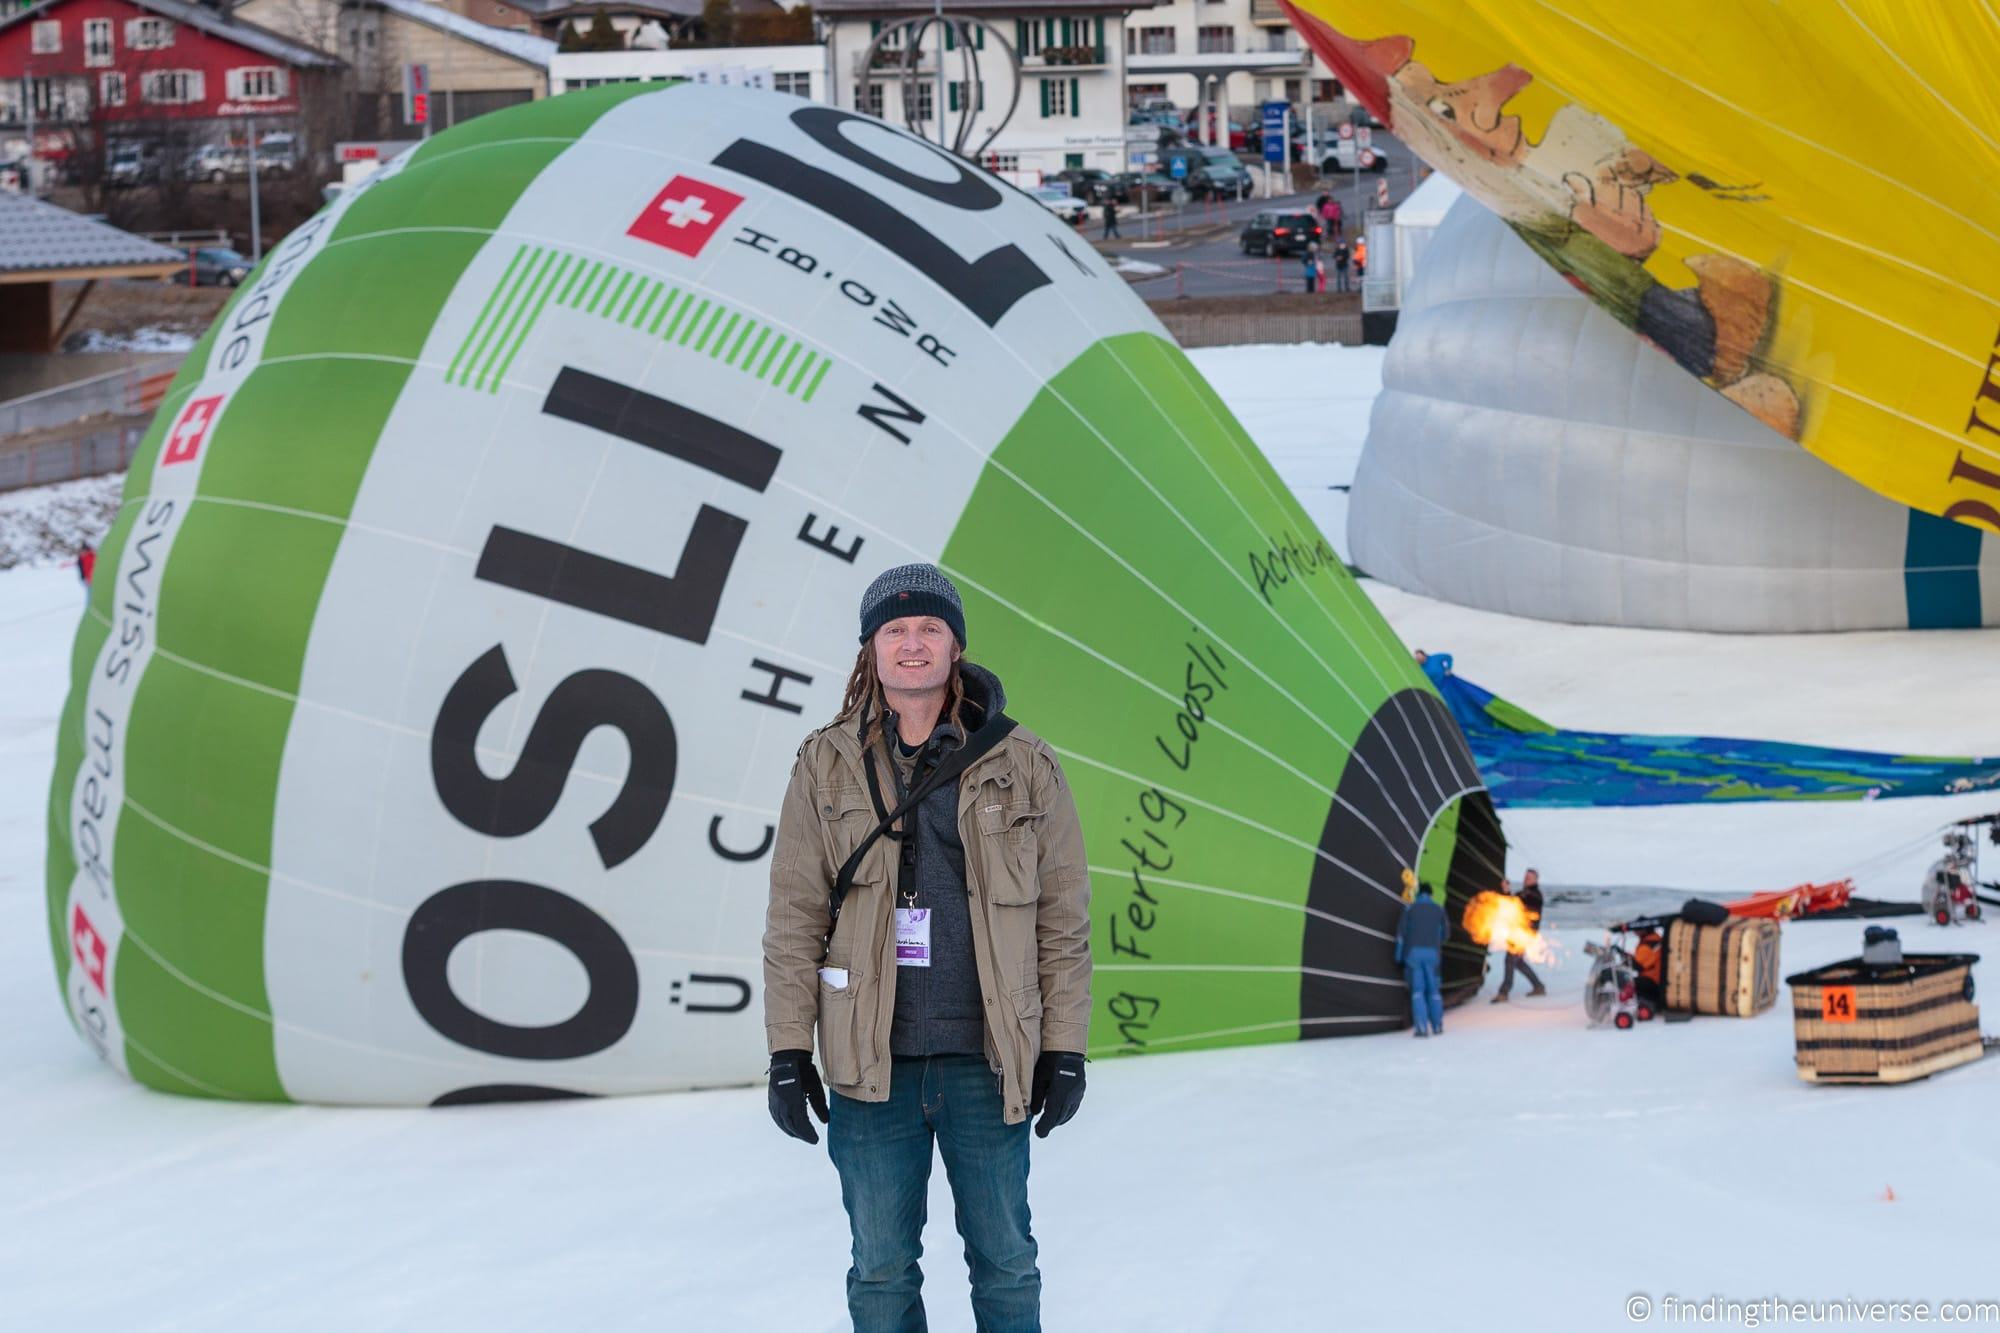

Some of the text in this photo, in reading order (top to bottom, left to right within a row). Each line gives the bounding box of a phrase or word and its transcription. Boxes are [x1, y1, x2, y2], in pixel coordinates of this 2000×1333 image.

[711, 106, 1055, 328] LO
[106, 500, 174, 685] swiss
[402, 365, 783, 1107] OSLI
[1110, 787, 1188, 960] Fertig
[1154, 625, 1228, 772] Loosli
[1827, 993, 1850, 1016] 14
